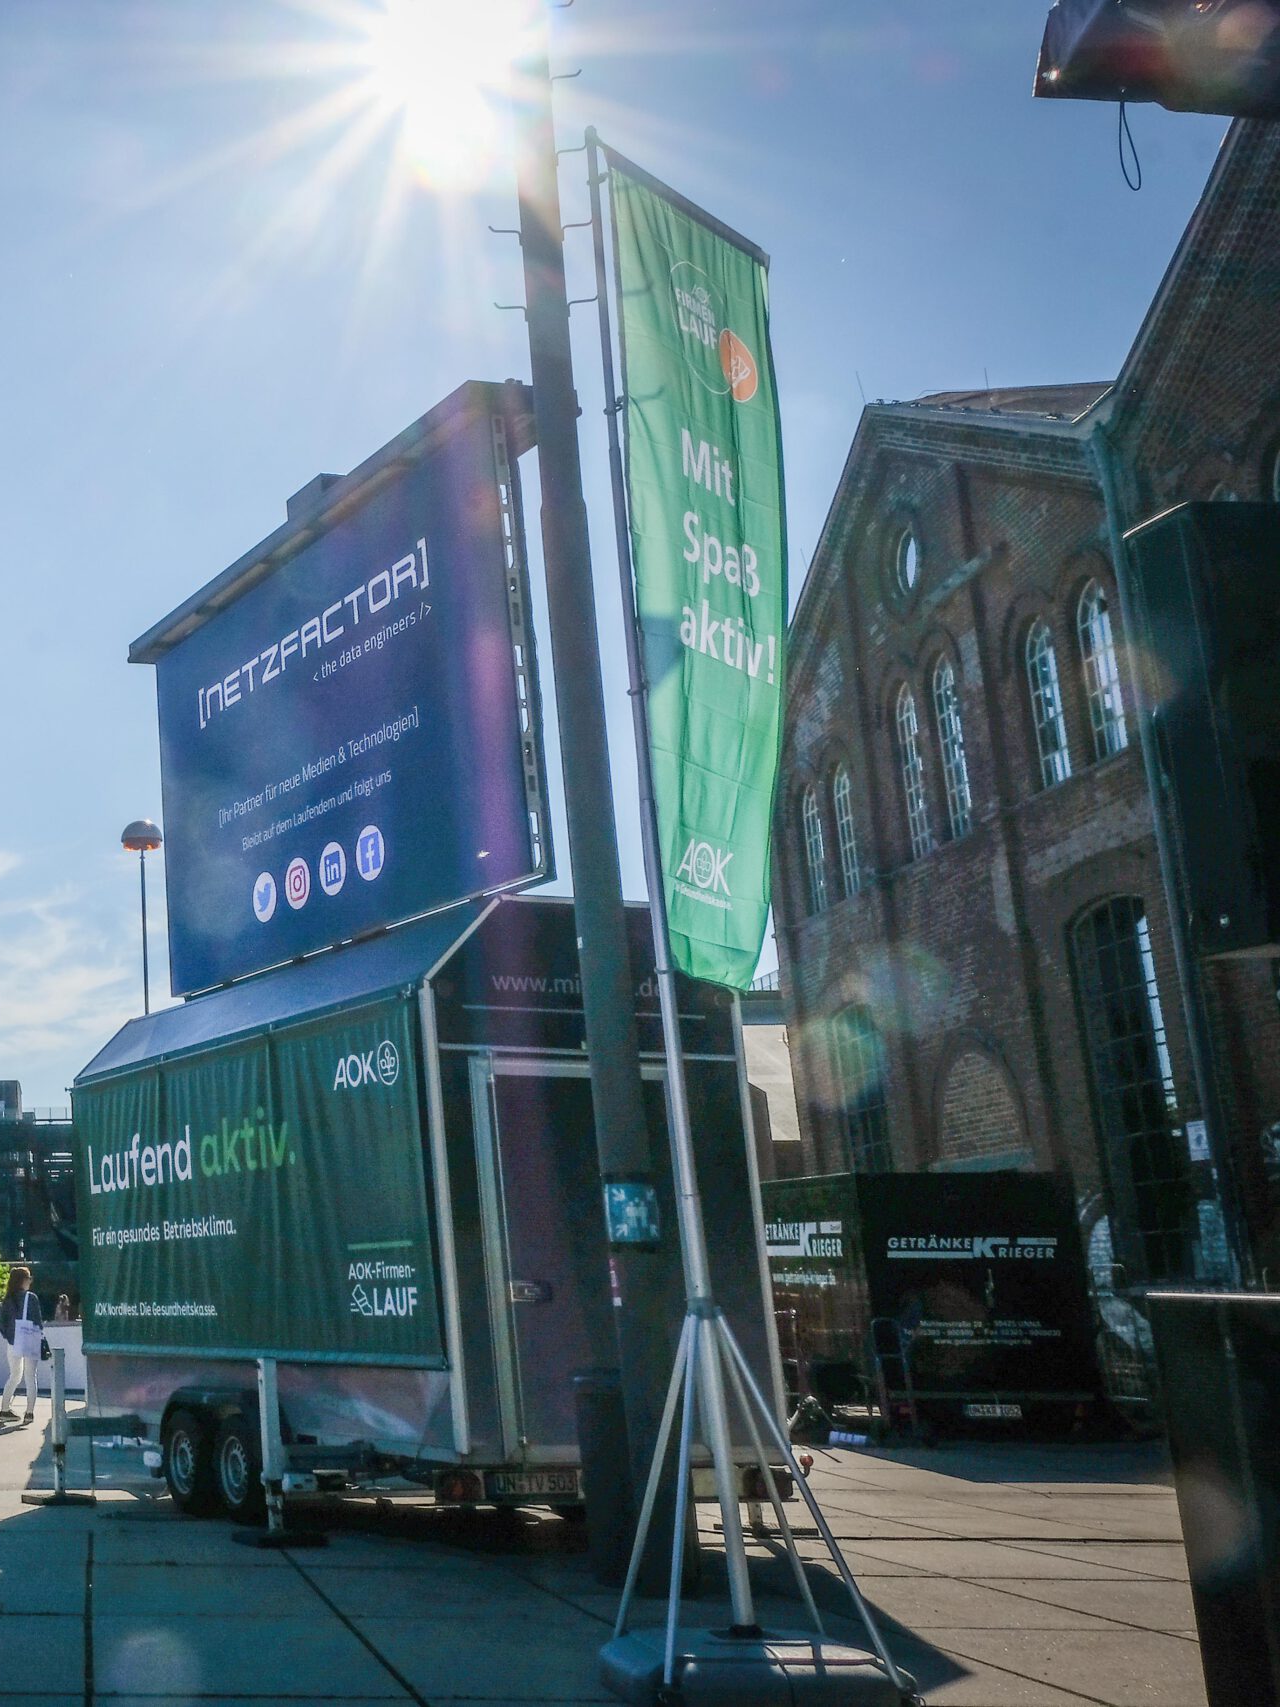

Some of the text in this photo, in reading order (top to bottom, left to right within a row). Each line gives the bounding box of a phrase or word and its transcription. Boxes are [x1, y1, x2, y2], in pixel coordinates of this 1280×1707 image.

[675, 287, 715, 327] FIRMEN
[678, 306, 717, 350] LAUF
[681, 427, 735, 507] Mit
[682, 510, 760, 598] Spaß
[321, 658, 337, 678] the
[339, 643, 362, 667] data
[364, 611, 416, 652] engineers
[680, 599, 776, 685] aktiv!
[233, 793, 264, 819] Partner
[265, 783, 277, 802] für
[279, 773, 301, 794] neue
[302, 755, 336, 783] Medien
[338, 746, 347, 764] &
[242, 769, 392, 851] Bleibt auf dem Laufendem und folgt uns
[676, 838, 734, 897] AOK
[333, 1050, 378, 1091] AOK
[88, 1105, 296, 1195] Laufend aktiv.
[93, 1214, 237, 1250] Für ein gesundes Betriebsklima.
[766, 1217, 800, 1240] ETRÄNKE
[887, 1234, 1055, 1259] GETRÄNKE KRIEGER
[348, 1261, 416, 1281] AOK-Firmen-
[94, 1303, 108, 1316] AOK
[139, 1302, 152, 1316] Die
[152, 1301, 218, 1317] Gesundheitskasse.
[373, 1286, 417, 1317] LAUF
